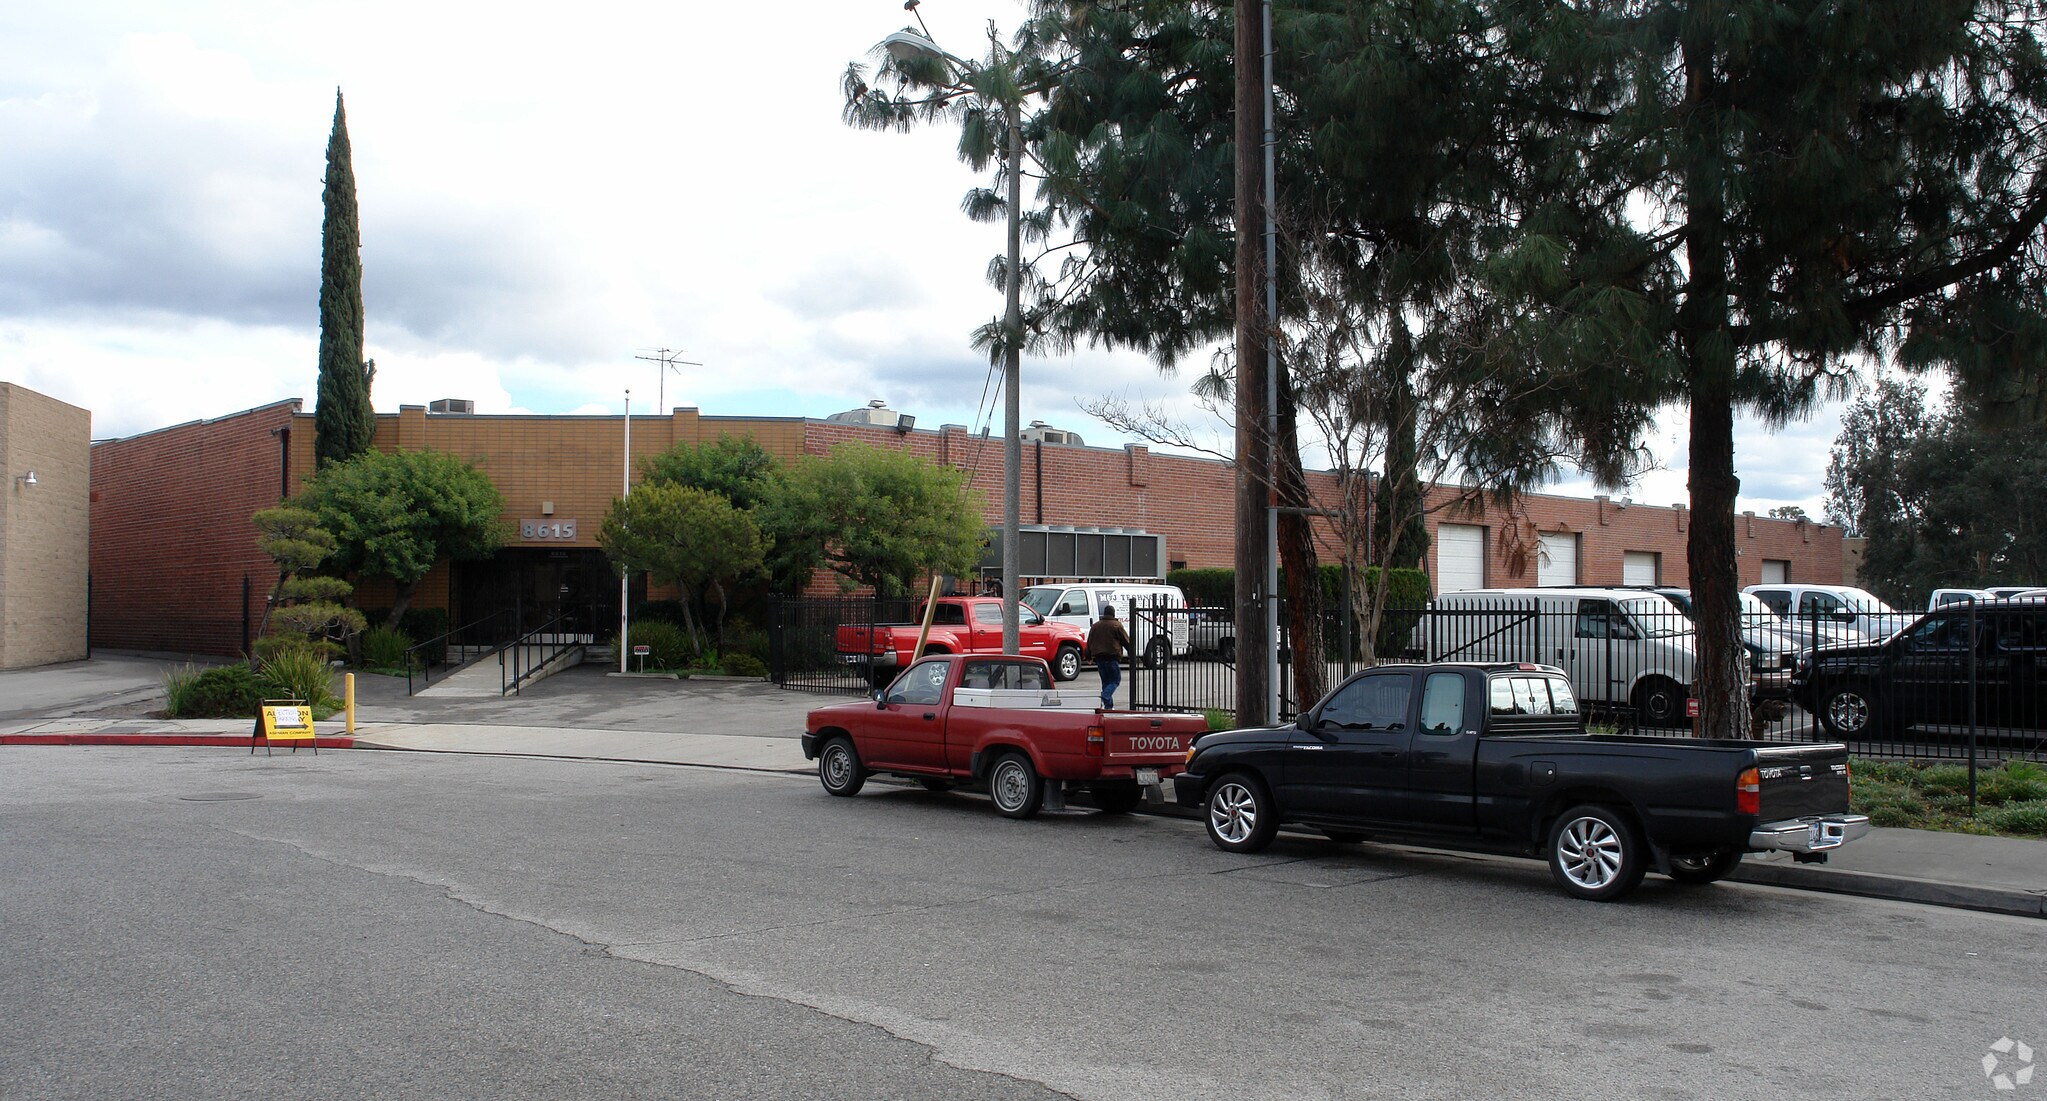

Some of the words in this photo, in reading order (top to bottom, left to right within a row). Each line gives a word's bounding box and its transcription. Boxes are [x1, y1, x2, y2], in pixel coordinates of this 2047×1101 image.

[522, 523, 574, 538] 8615
[1129, 736, 1180, 750] TOYOTA
[1759, 768, 1783, 779] TOYOTA
